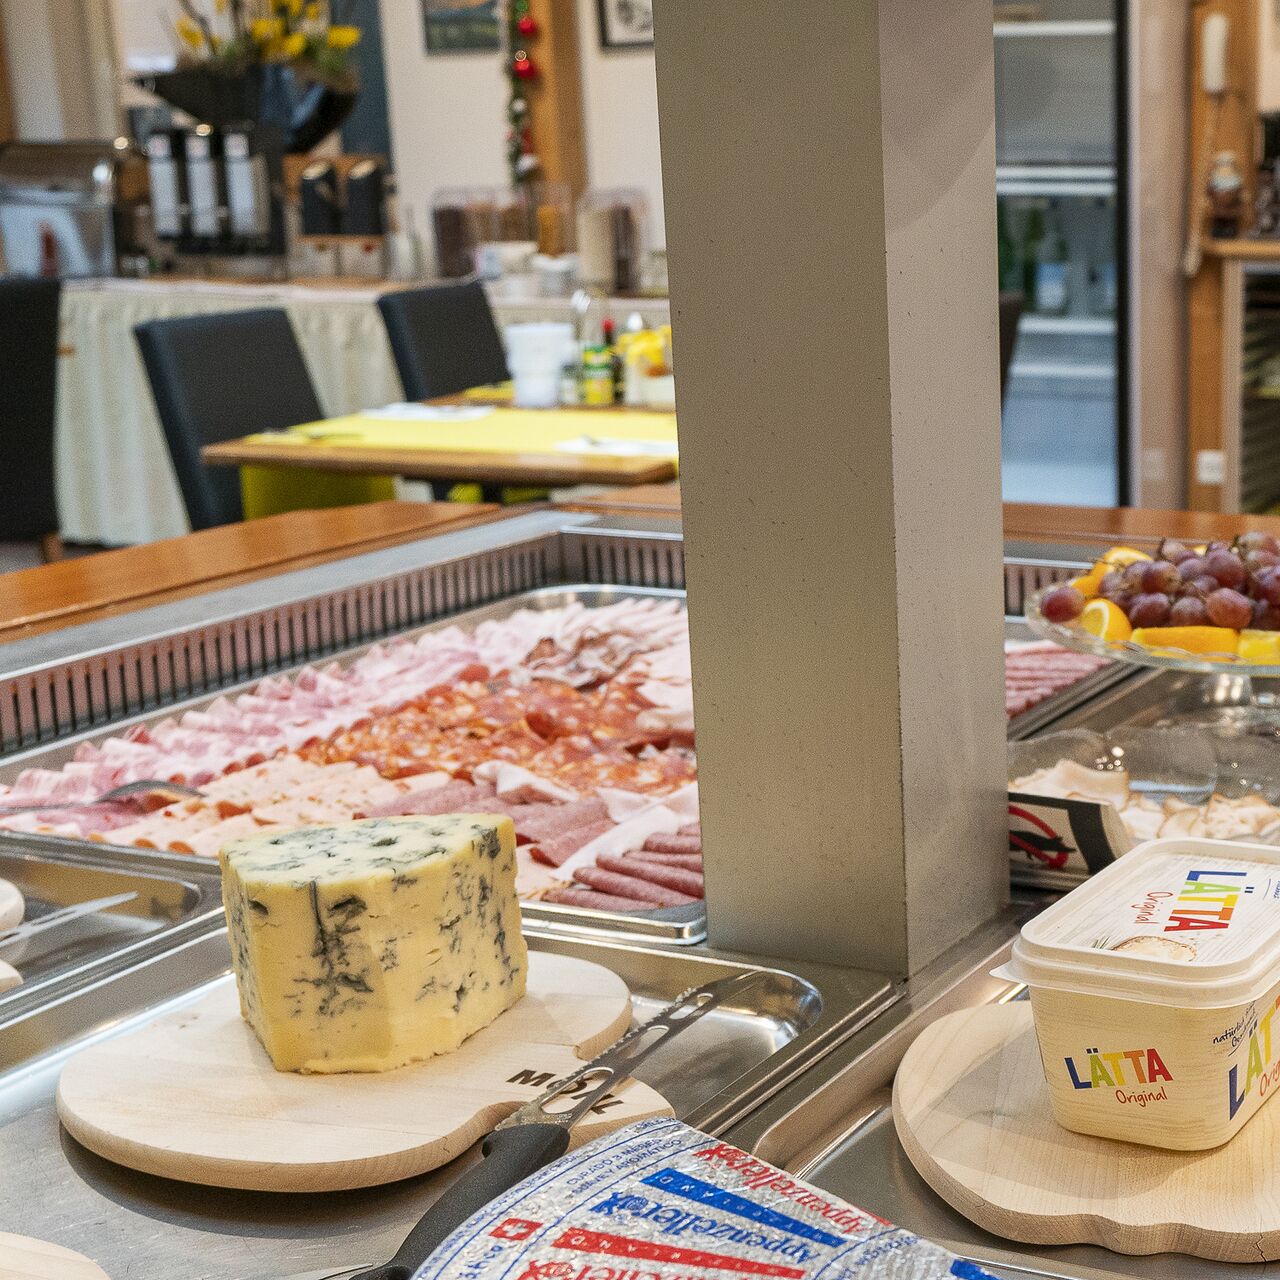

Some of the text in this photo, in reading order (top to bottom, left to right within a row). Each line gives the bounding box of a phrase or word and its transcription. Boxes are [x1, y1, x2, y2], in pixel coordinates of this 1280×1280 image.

[1131, 891, 1174, 924] Original
[1164, 870, 1255, 932] LÄTTA
[1064, 1047, 1174, 1090] LÄTTA
[1115, 1086, 1168, 1108] Original
[567, 1158, 613, 1185] CURADO
[729, 1154, 867, 1236] Appenzeller
[641, 1202, 820, 1265] Appenzeller
